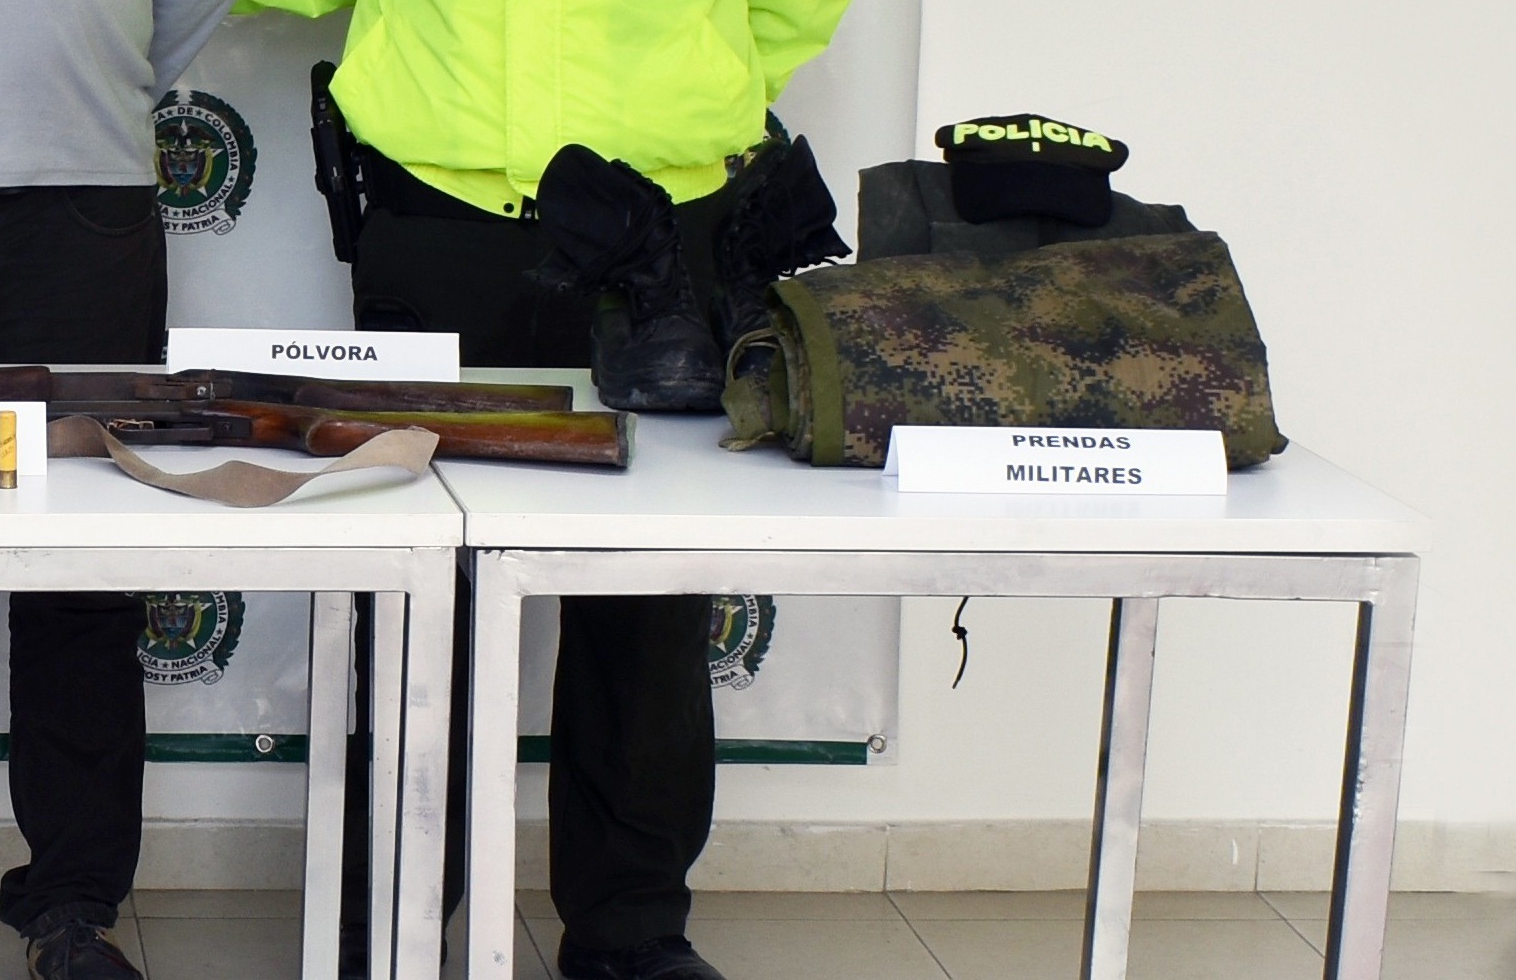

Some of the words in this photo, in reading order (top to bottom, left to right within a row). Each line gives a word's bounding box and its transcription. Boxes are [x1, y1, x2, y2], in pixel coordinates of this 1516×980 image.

[178, 107, 193, 116] DE
[205, 114, 238, 171] COLOMBIA
[953, 119, 1112, 153] POLICIA
[182, 183, 233, 217] NACIONAL
[182, 215, 220, 231] PATRIA
[272, 341, 377, 361] PÓLVORA
[1012, 435, 1131, 450] PRENDAS
[1006, 464, 1142, 485] MILITARES
[171, 635, 222, 669] NACIONAL
[171, 666, 208, 682] PATRIA
